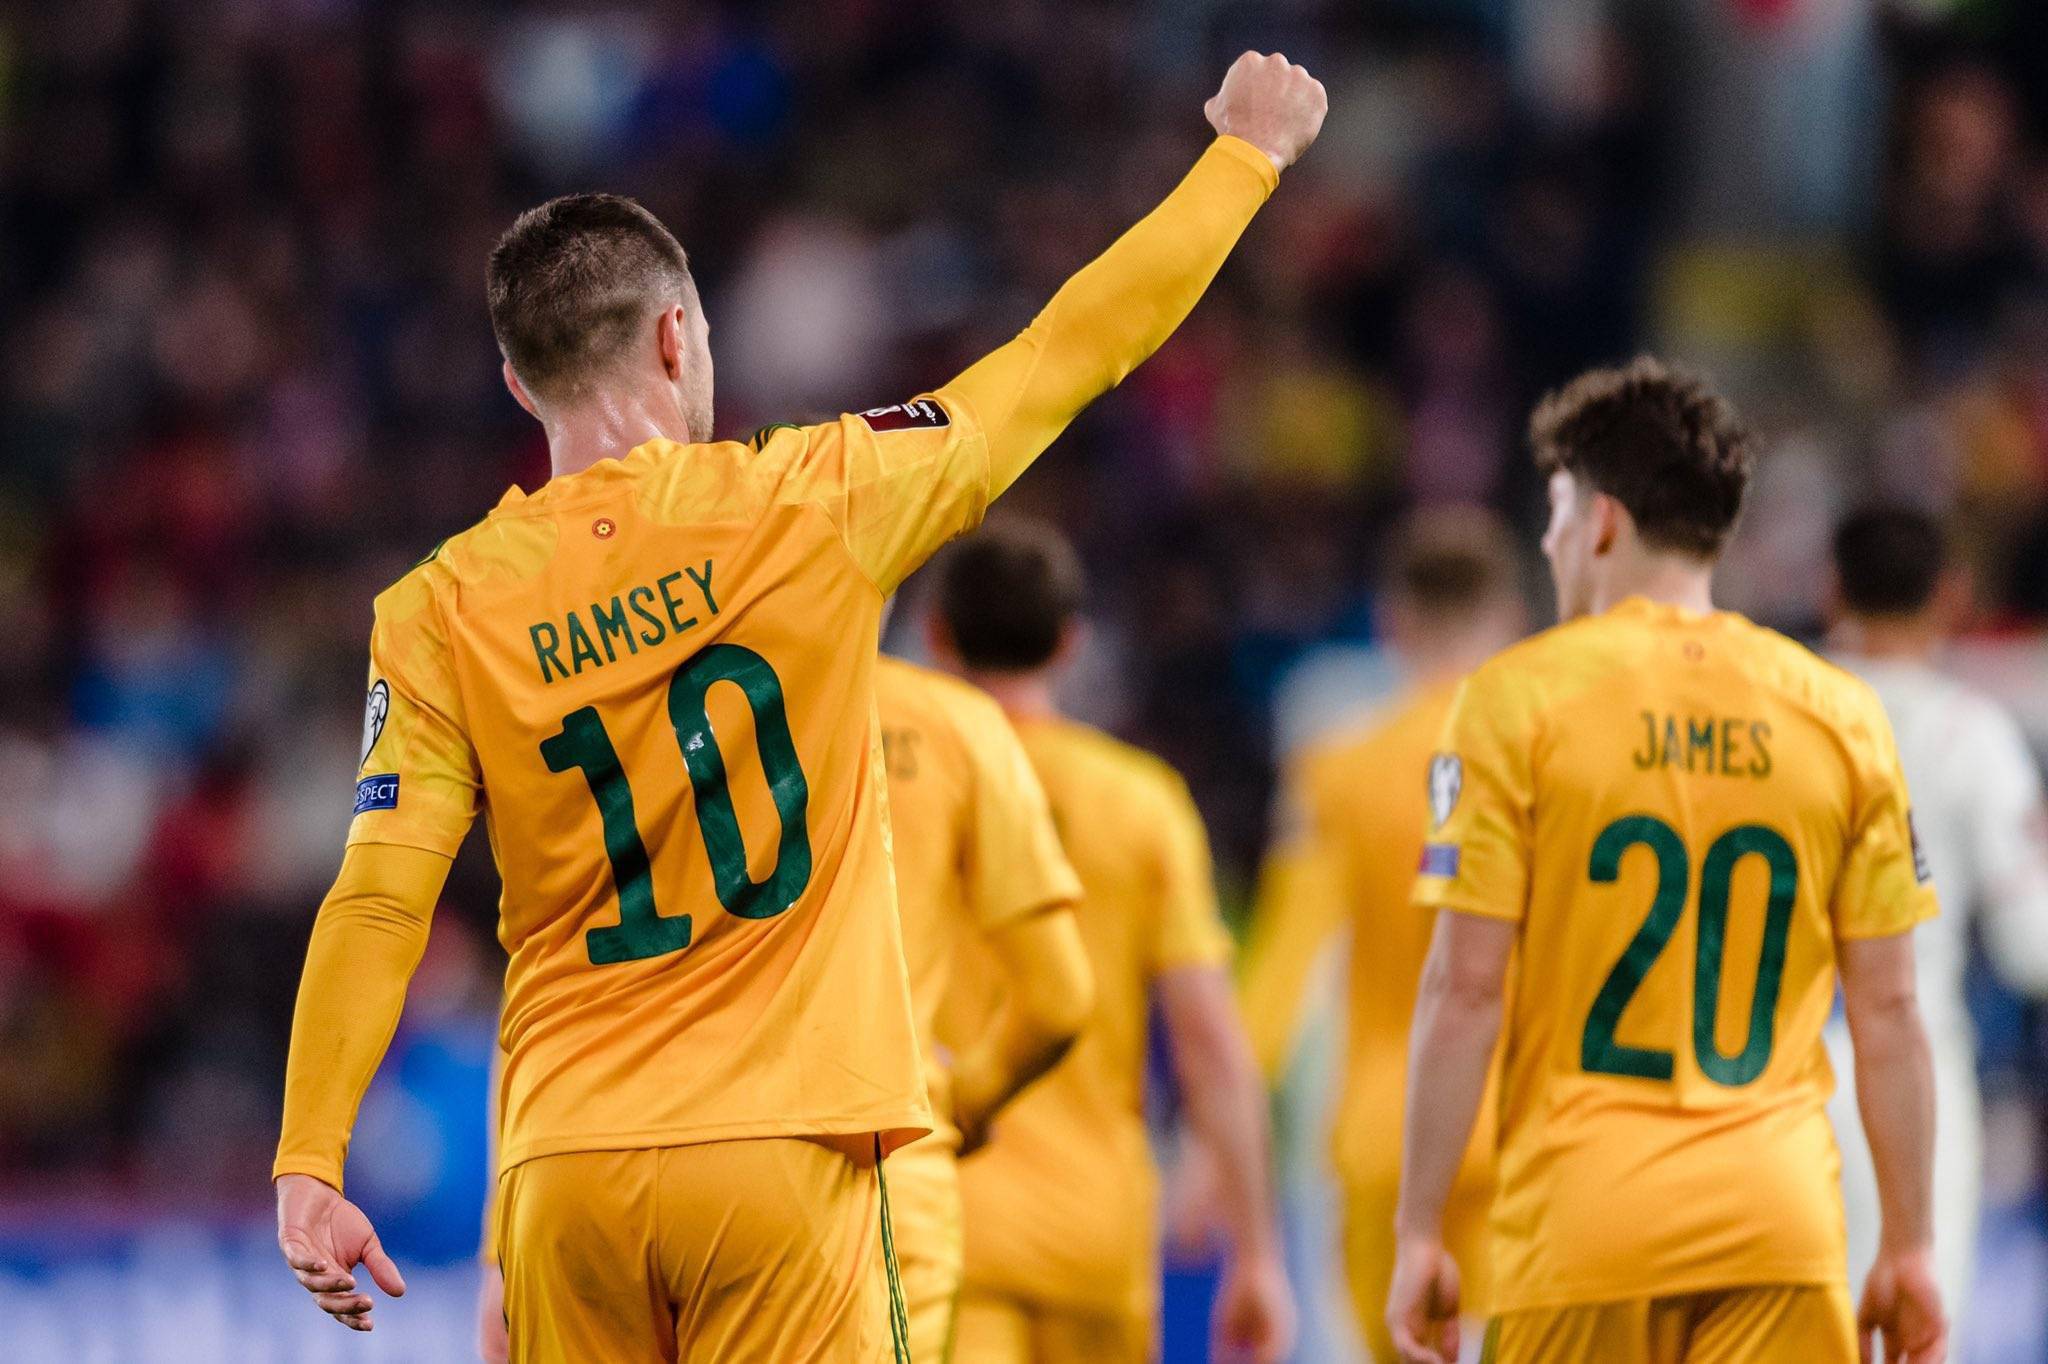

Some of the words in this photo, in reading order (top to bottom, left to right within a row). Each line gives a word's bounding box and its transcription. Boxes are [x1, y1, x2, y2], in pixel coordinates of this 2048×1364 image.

[529, 559, 719, 684] RAMSEY
[539, 642, 812, 966] 10
[1634, 711, 1773, 779] JAMES
[1580, 814, 1800, 1087] 20
